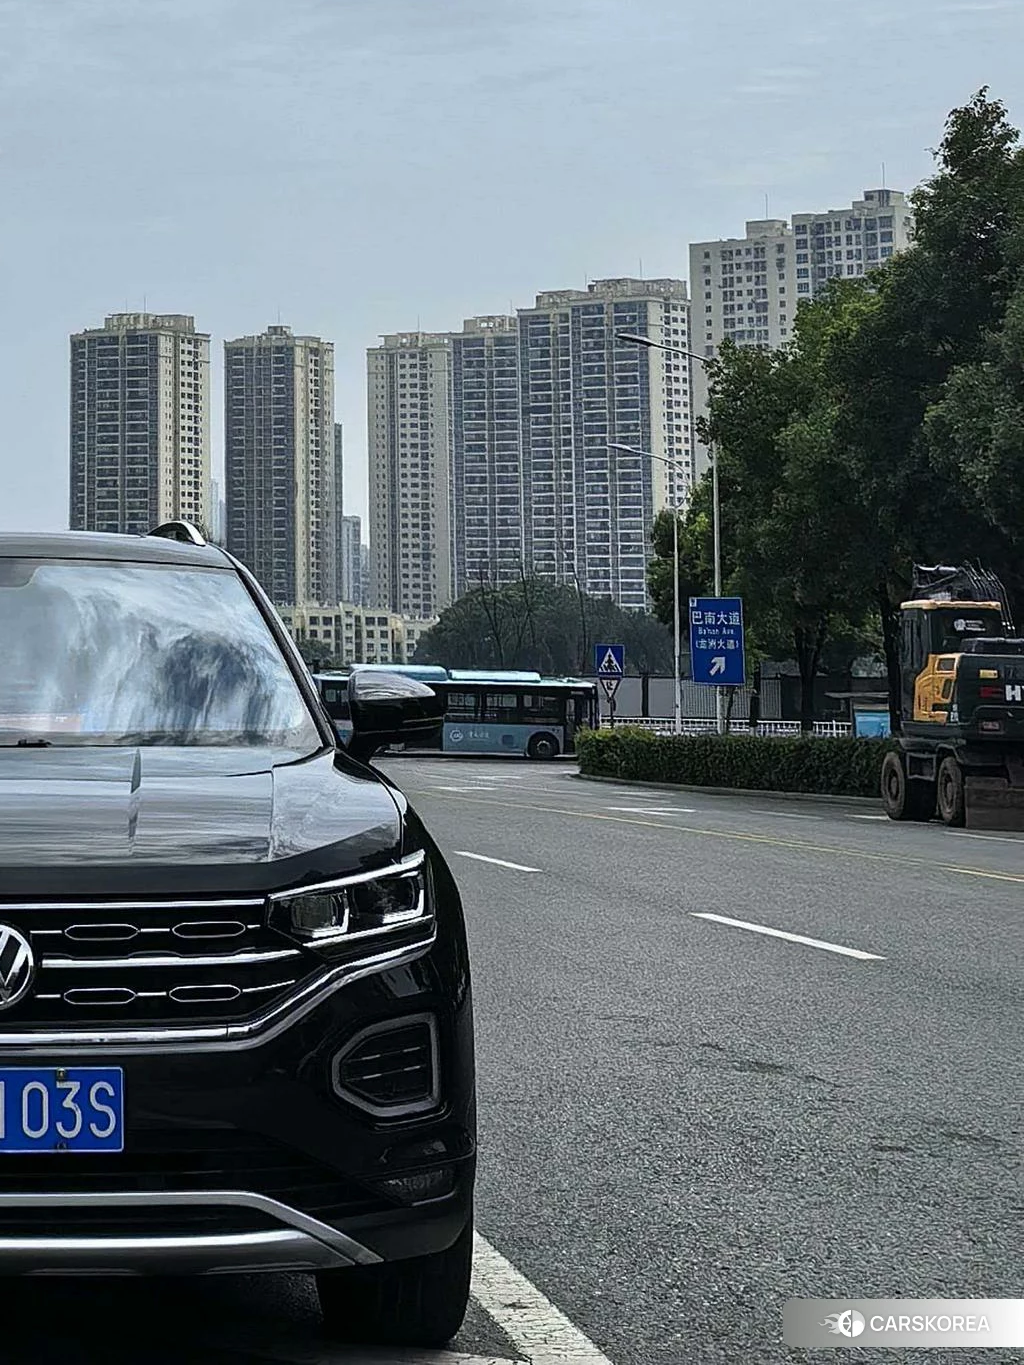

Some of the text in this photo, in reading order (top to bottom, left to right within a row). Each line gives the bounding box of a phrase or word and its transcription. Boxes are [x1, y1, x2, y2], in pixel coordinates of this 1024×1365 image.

[692, 610, 740, 625] 巴南大道
[1005, 684, 1024, 702] H
